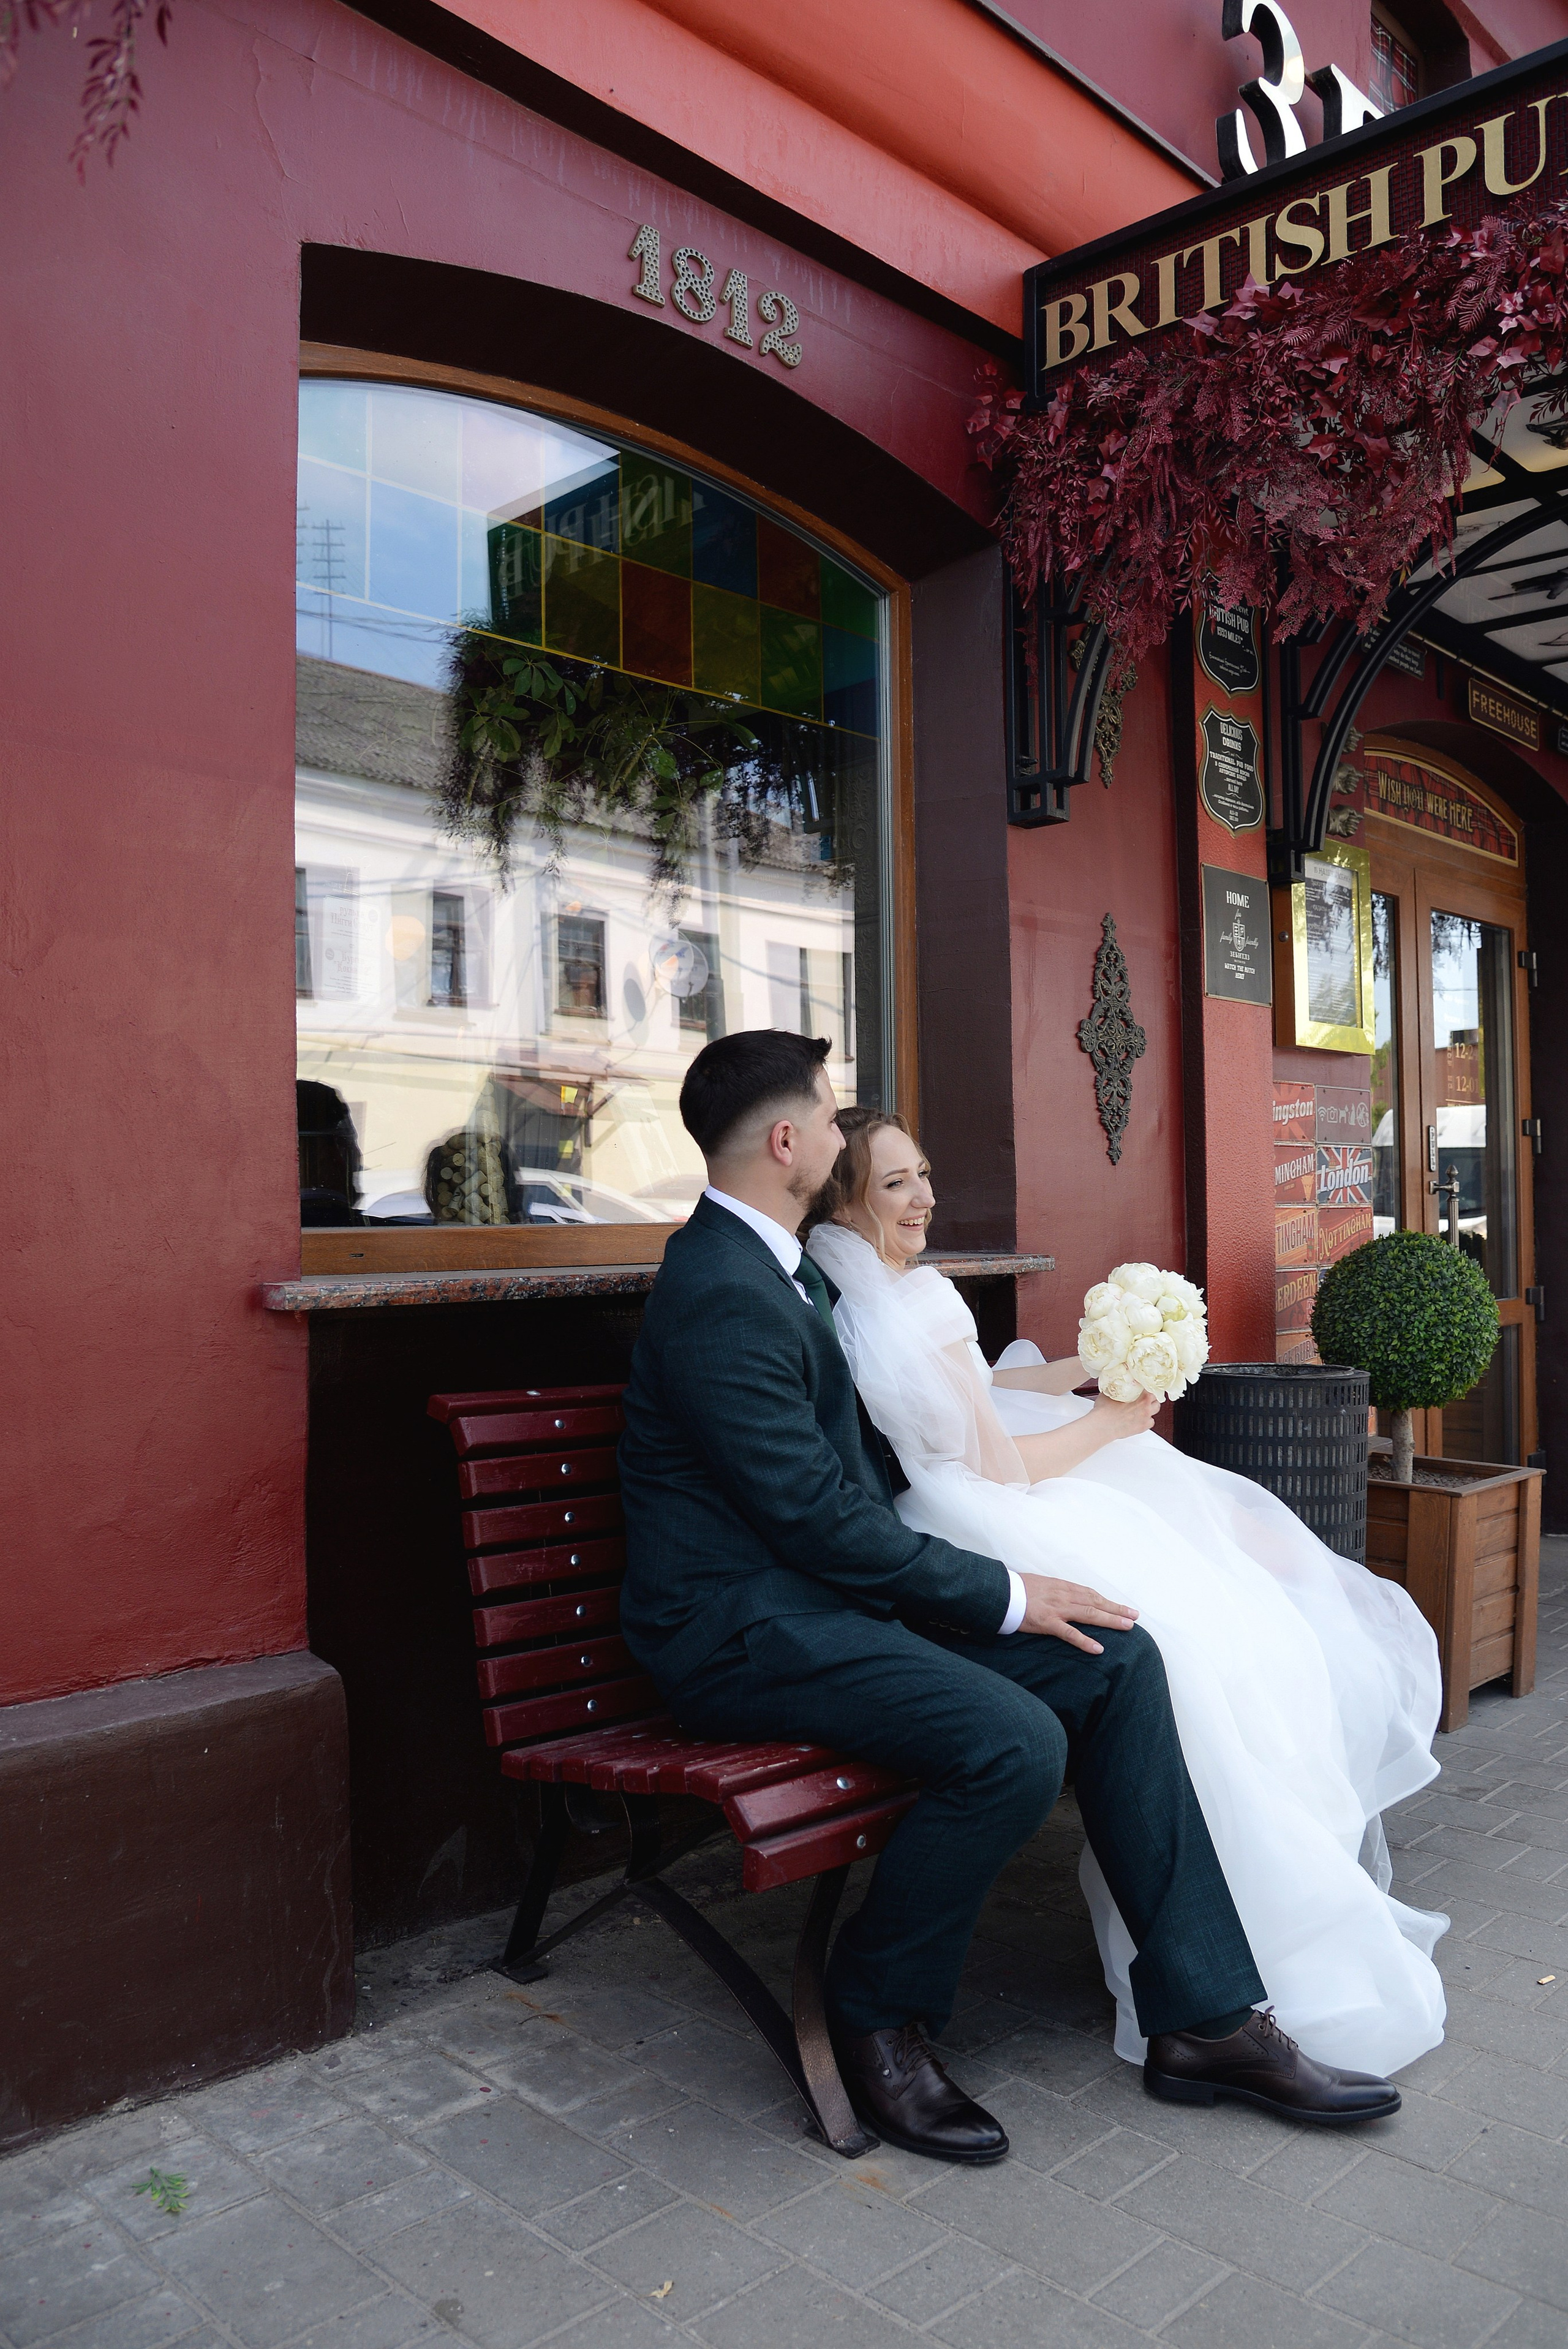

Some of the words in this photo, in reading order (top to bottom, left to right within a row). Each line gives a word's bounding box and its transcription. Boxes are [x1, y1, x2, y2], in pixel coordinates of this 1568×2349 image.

[1041, 163, 1401, 371] BRITISH
[1413, 92, 1568, 229] PU
[628, 224, 802, 369] 1812
[1237, 615, 1250, 634] PUB
[1472, 690, 1537, 739] FREEHOUSE
[1210, 751, 1235, 765] TRADITIONAL
[1244, 763, 1254, 772] FOOD
[1223, 736, 1242, 752] DRINKS
[1378, 771, 1401, 805] WISH
[1427, 791, 1447, 821] WERE
[1449, 801, 1472, 833] HERE
[1226, 891, 1250, 908] HOME
[1320, 1158, 1368, 1193] London
[1320, 1213, 1372, 1261] NOTTINGHAM
